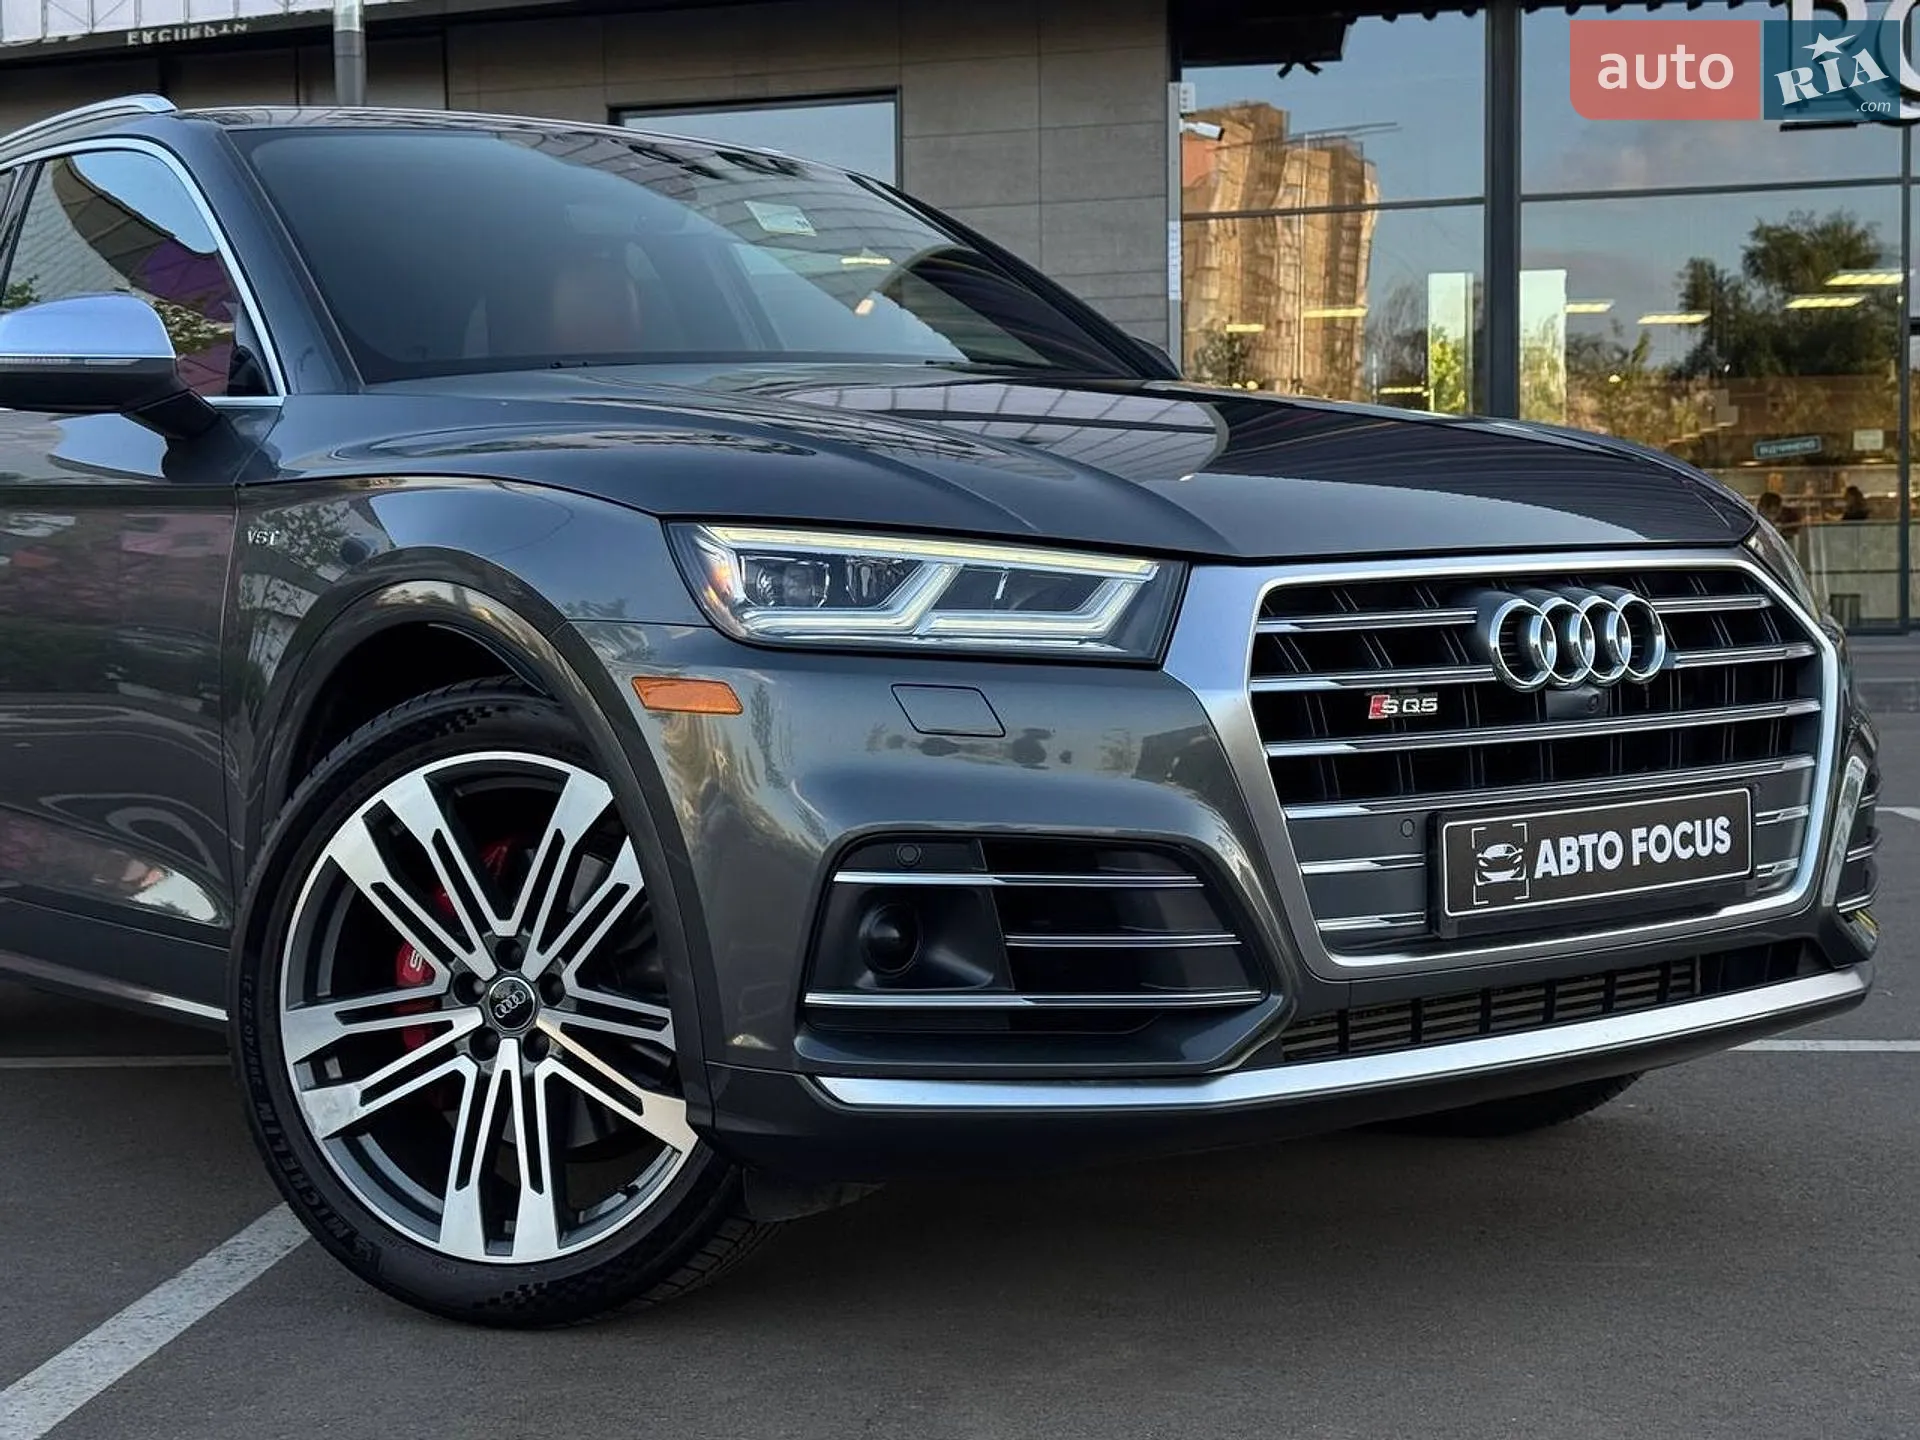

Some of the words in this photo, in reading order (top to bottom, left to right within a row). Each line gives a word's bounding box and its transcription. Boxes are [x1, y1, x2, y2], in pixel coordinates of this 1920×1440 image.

[1376, 697, 1438, 715] SQ5
[1534, 830, 1624, 879] АВТО
[1631, 815, 1732, 866] FOCUS
